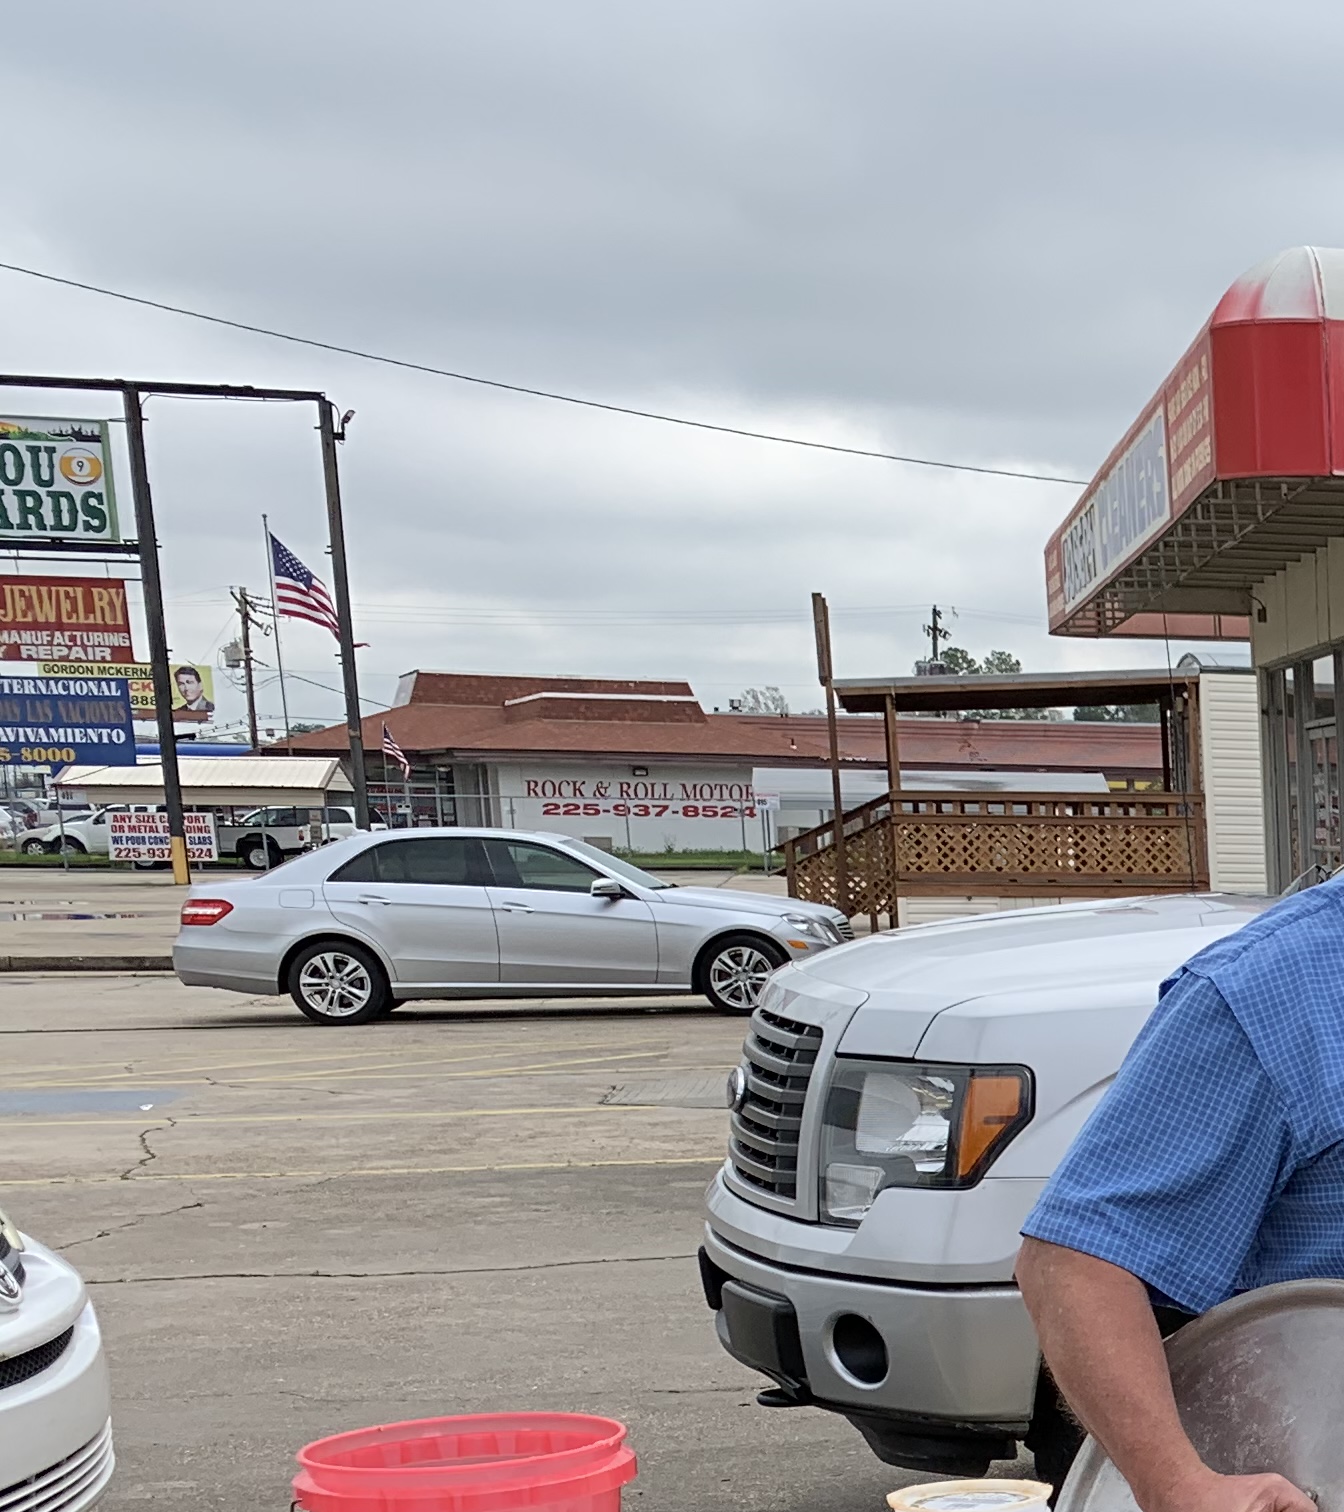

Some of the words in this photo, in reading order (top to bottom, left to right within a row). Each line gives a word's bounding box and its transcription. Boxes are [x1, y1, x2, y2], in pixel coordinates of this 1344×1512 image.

[76, 460, 85, 472] 9
[1, 584, 124, 625] JEWELRY
[0, 629, 130, 646] MANUFACTURING
[20, 645, 111, 661] REPAIR
[43, 664, 94, 676] GORDON
[525, 779, 587, 799] ROCK
[592, 781, 611, 799] &
[619, 781, 675, 801] ROLL
[542, 802, 757, 819] 225-937-8524
[112, 814, 133, 824] ANY
[134, 814, 157, 824] SIZE
[110, 824, 126, 834] OR
[127, 824, 160, 834] METAL
[125, 835, 147, 846] POUR
[188, 836, 213, 846] SLABS
